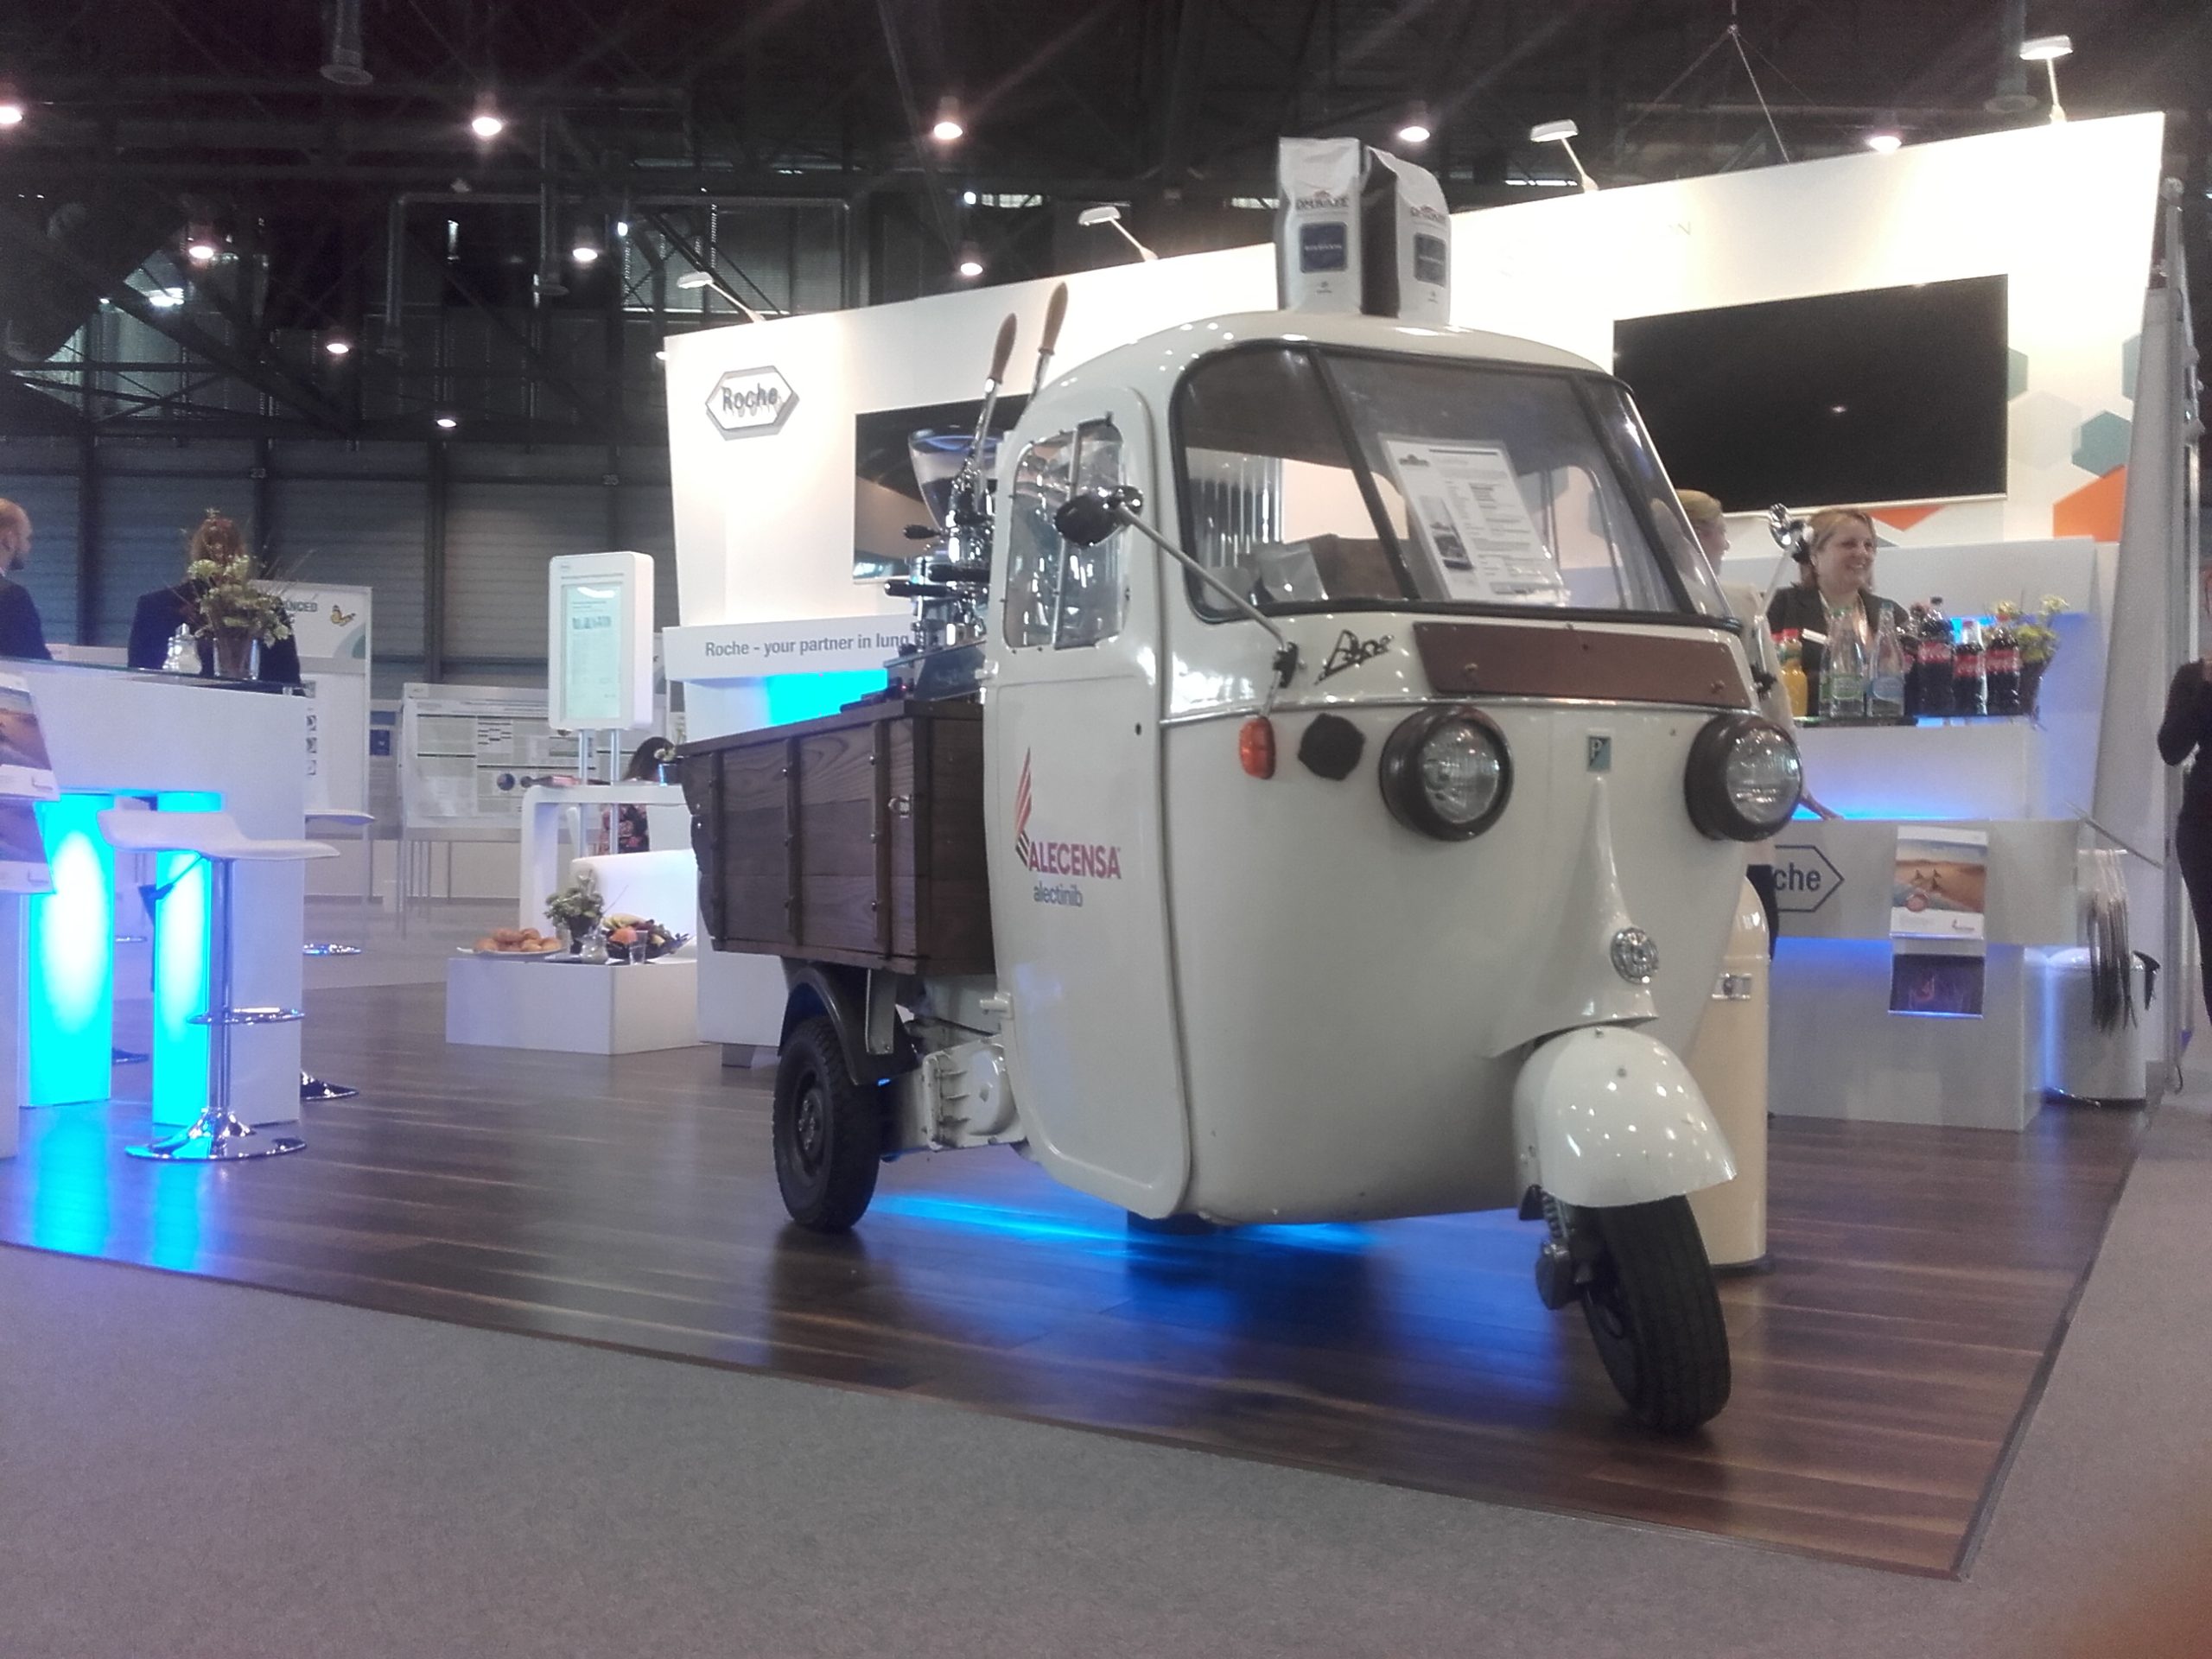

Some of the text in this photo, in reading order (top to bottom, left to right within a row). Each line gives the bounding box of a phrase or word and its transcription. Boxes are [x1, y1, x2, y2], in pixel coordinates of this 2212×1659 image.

[721, 383, 779, 411] Roche
[284, 601, 318, 612] ANCED
[705, 641, 749, 656] Roche
[764, 640, 795, 657] your
[800, 635, 854, 655] partner
[858, 633, 872, 649] in
[1029, 841, 1122, 879] ALECENSA
[1773, 861, 1821, 891] che
[1033, 880, 1083, 907] alectinib
